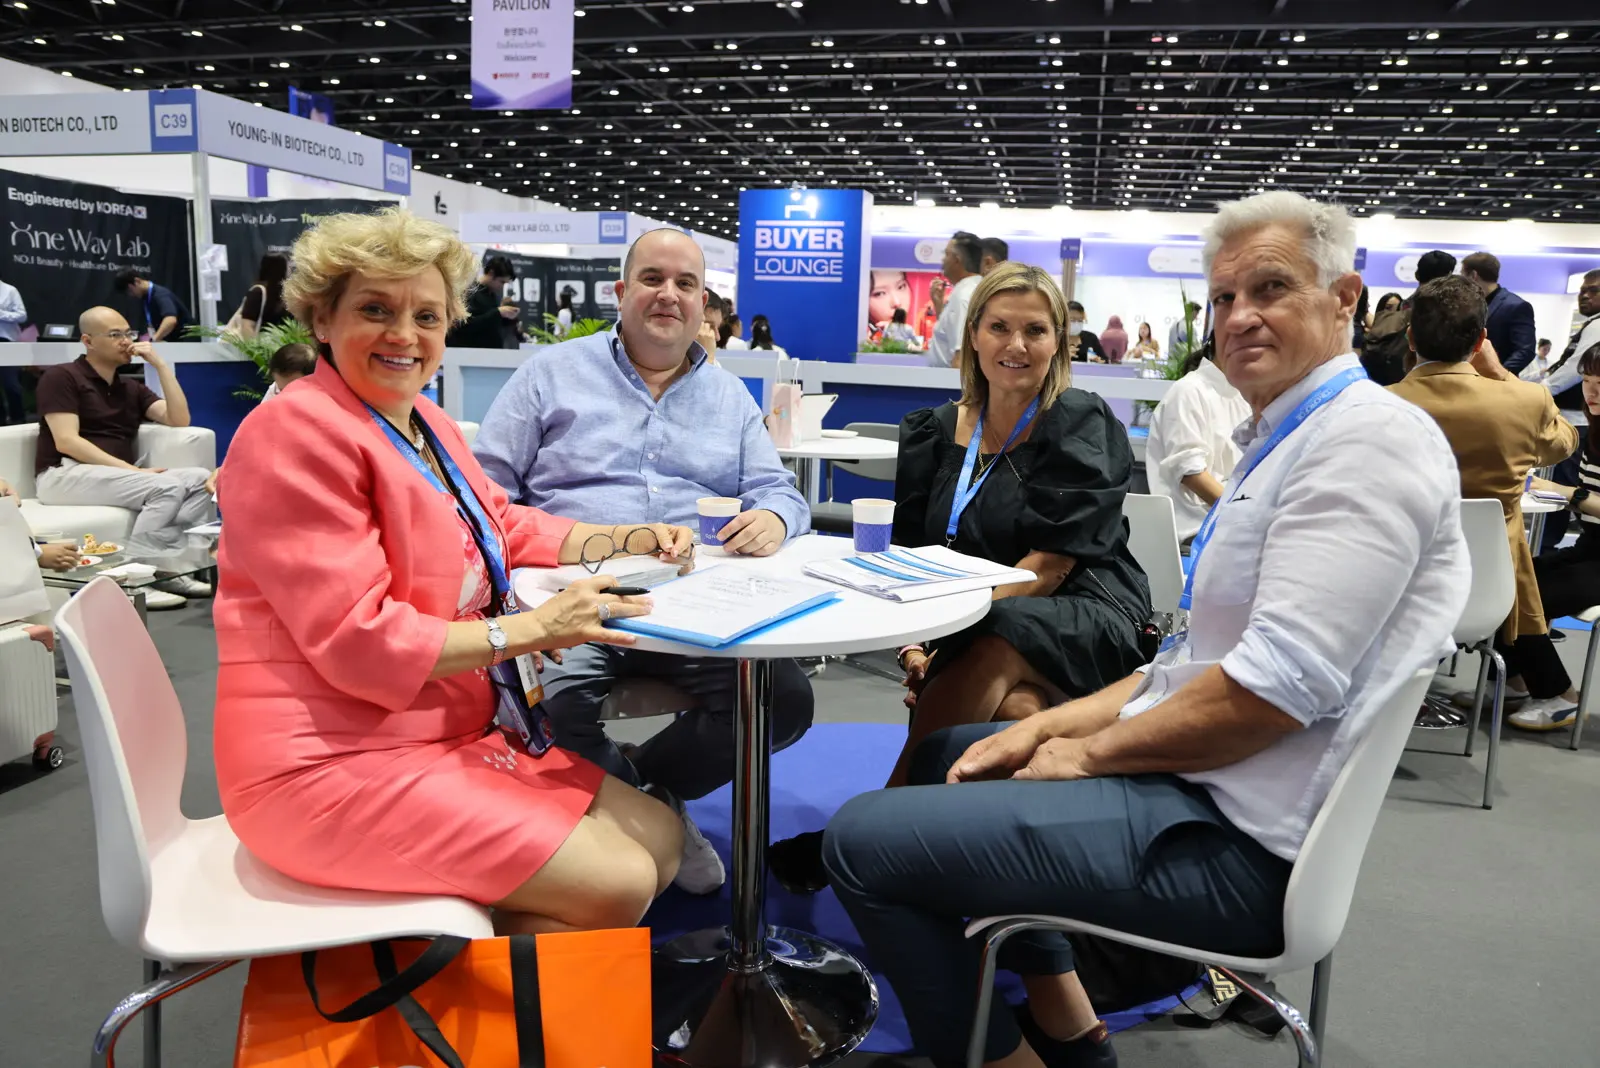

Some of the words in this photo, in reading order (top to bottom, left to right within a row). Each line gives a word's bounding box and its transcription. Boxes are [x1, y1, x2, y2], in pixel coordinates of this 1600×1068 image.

[493, 0, 550, 11] PAVILION
[12, 117, 64, 133] BIOTECH
[67, 116, 91, 134] CO.,
[94, 115, 118, 131] LTD
[160, 114, 187, 129] C39
[228, 119, 282, 147] YOUNG-IN
[285, 136, 326, 158] BIOTECH
[328, 146, 346, 164] CO.,
[347, 152, 364, 166] LTD
[7, 187, 79, 210] Engineered
[80, 198, 95, 214] by
[96, 200, 134, 217] KOREA
[259, 213, 276, 225] Lab
[488, 224, 502, 233] ONE
[504, 223, 520, 232] WAY
[522, 223, 537, 233] LAB
[555, 223, 570, 232] LTD
[10, 221, 65, 251] One
[68, 228, 112, 260] Way
[116, 233, 150, 258] Lab
[755, 227, 844, 250] BUYER
[36, 256, 63, 269] Beauty
[754, 257, 843, 275] LOUNGE
